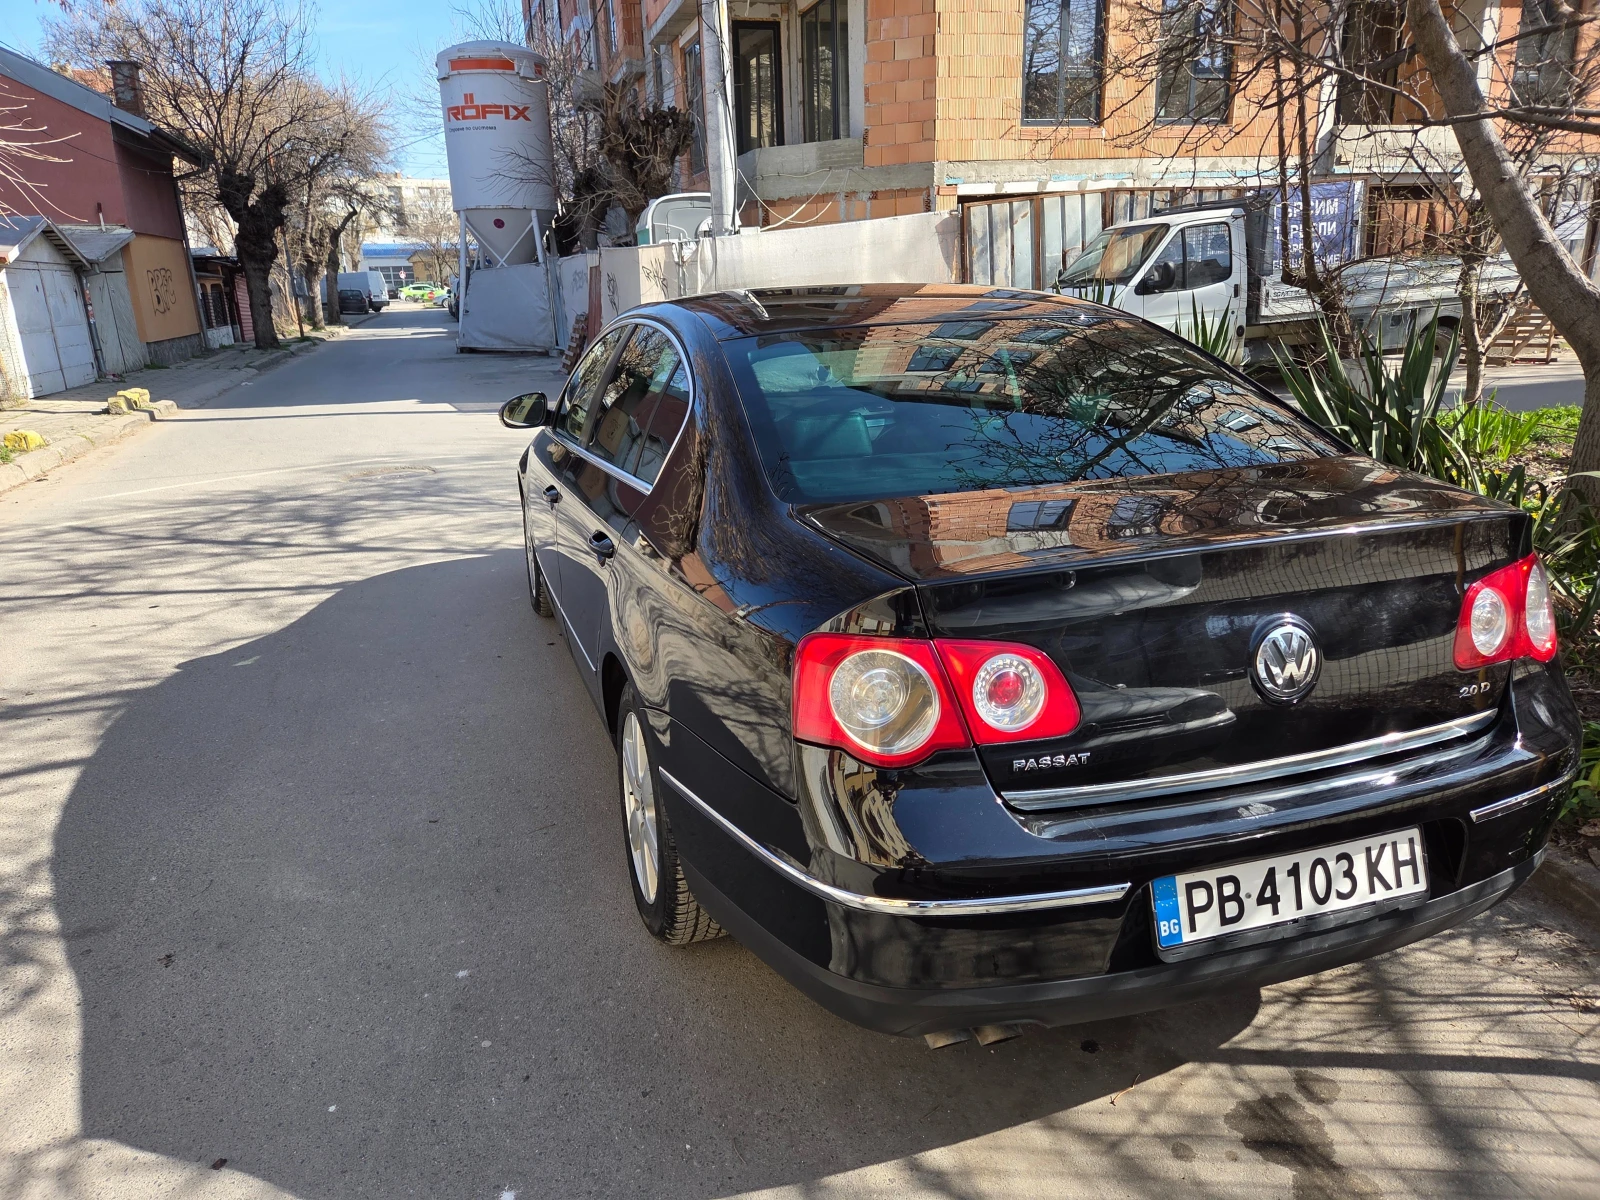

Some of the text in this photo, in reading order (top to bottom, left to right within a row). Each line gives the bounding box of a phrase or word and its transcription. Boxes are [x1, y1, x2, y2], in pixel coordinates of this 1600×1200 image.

[1257, 625, 1321, 697] VW
[1013, 752, 1091, 772] PASSAT
[1160, 919, 1180, 937] BG
